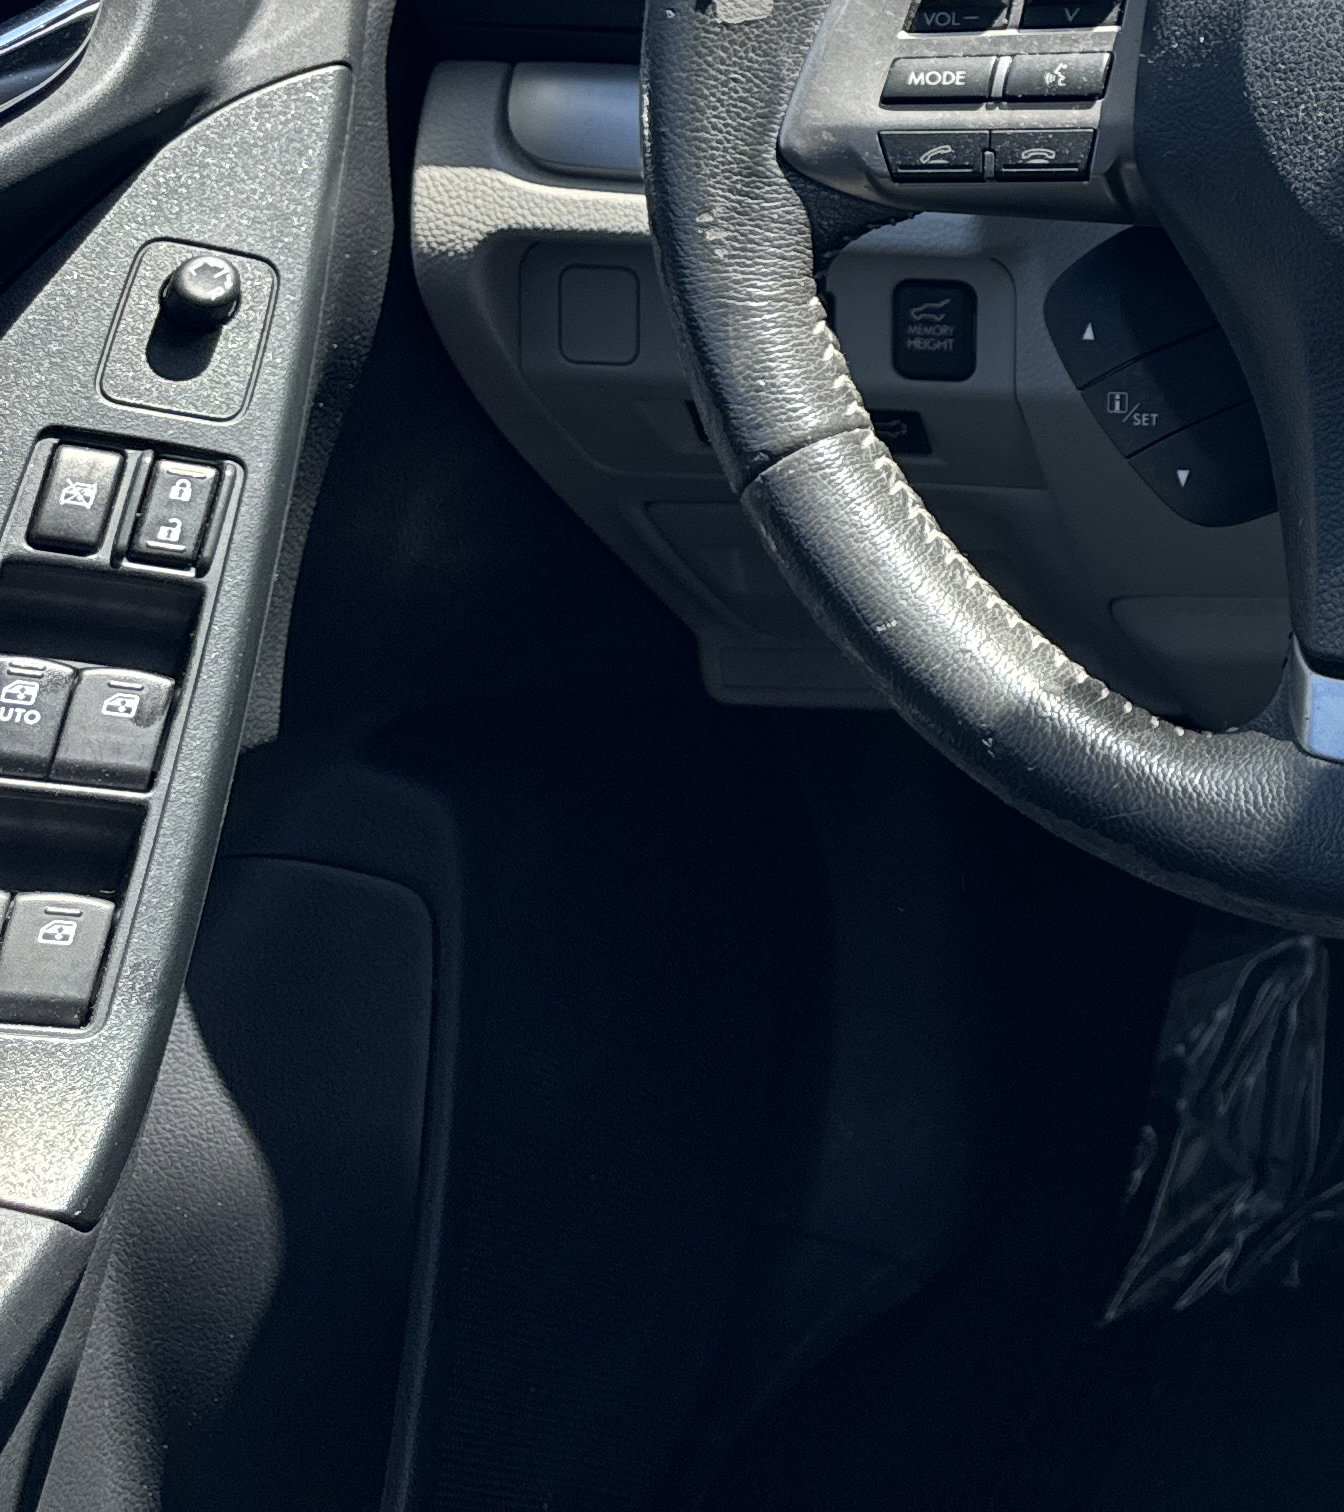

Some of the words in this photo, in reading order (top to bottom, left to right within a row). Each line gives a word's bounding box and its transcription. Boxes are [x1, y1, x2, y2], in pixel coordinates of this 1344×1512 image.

[923, 12, 960, 27] VOL
[907, 71, 967, 86] MODE
[0, 706, 42, 725] UTO
